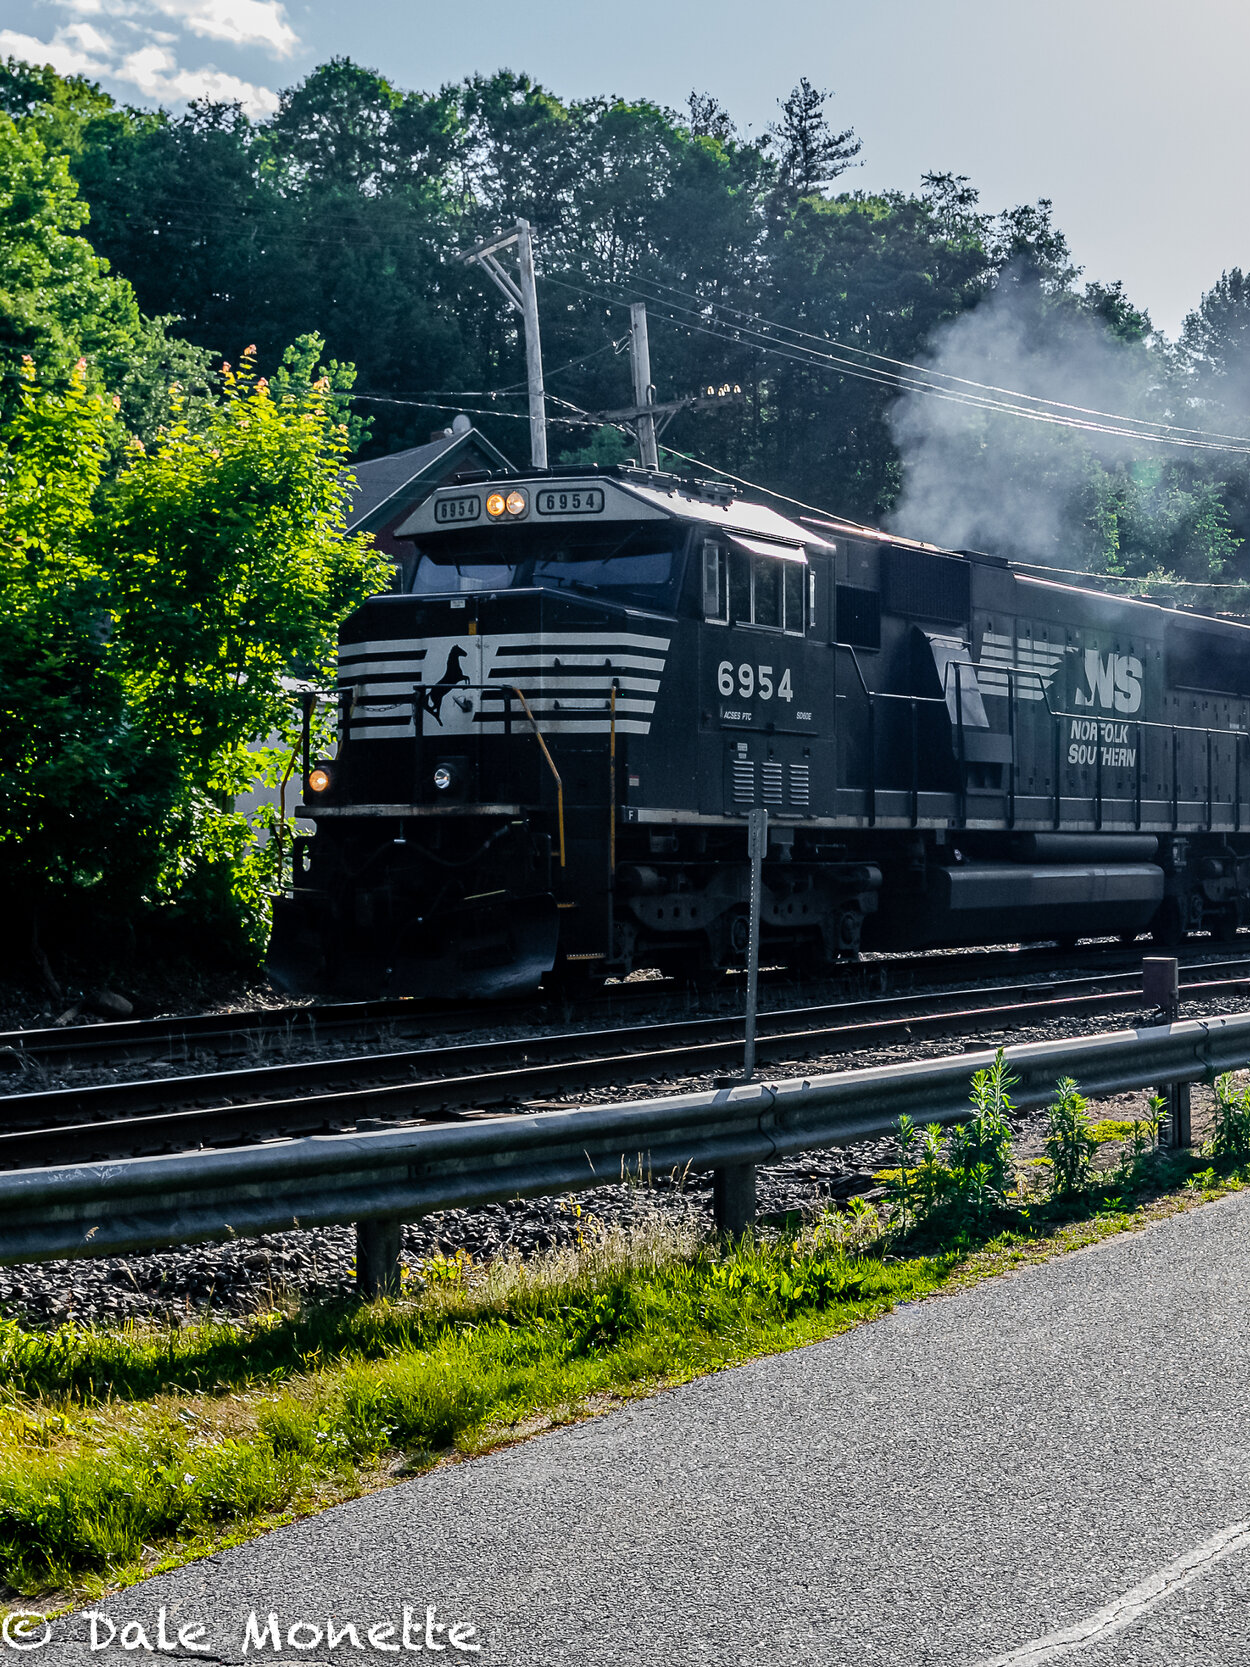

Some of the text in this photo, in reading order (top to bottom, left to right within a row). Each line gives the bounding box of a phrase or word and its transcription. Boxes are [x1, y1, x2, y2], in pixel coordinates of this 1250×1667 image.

[441, 500, 474, 518] 6954
[546, 493, 595, 510] 6954
[717, 660, 793, 702] 6954
[1074, 648, 1143, 713] NS
[723, 710, 741, 720] ACSES
